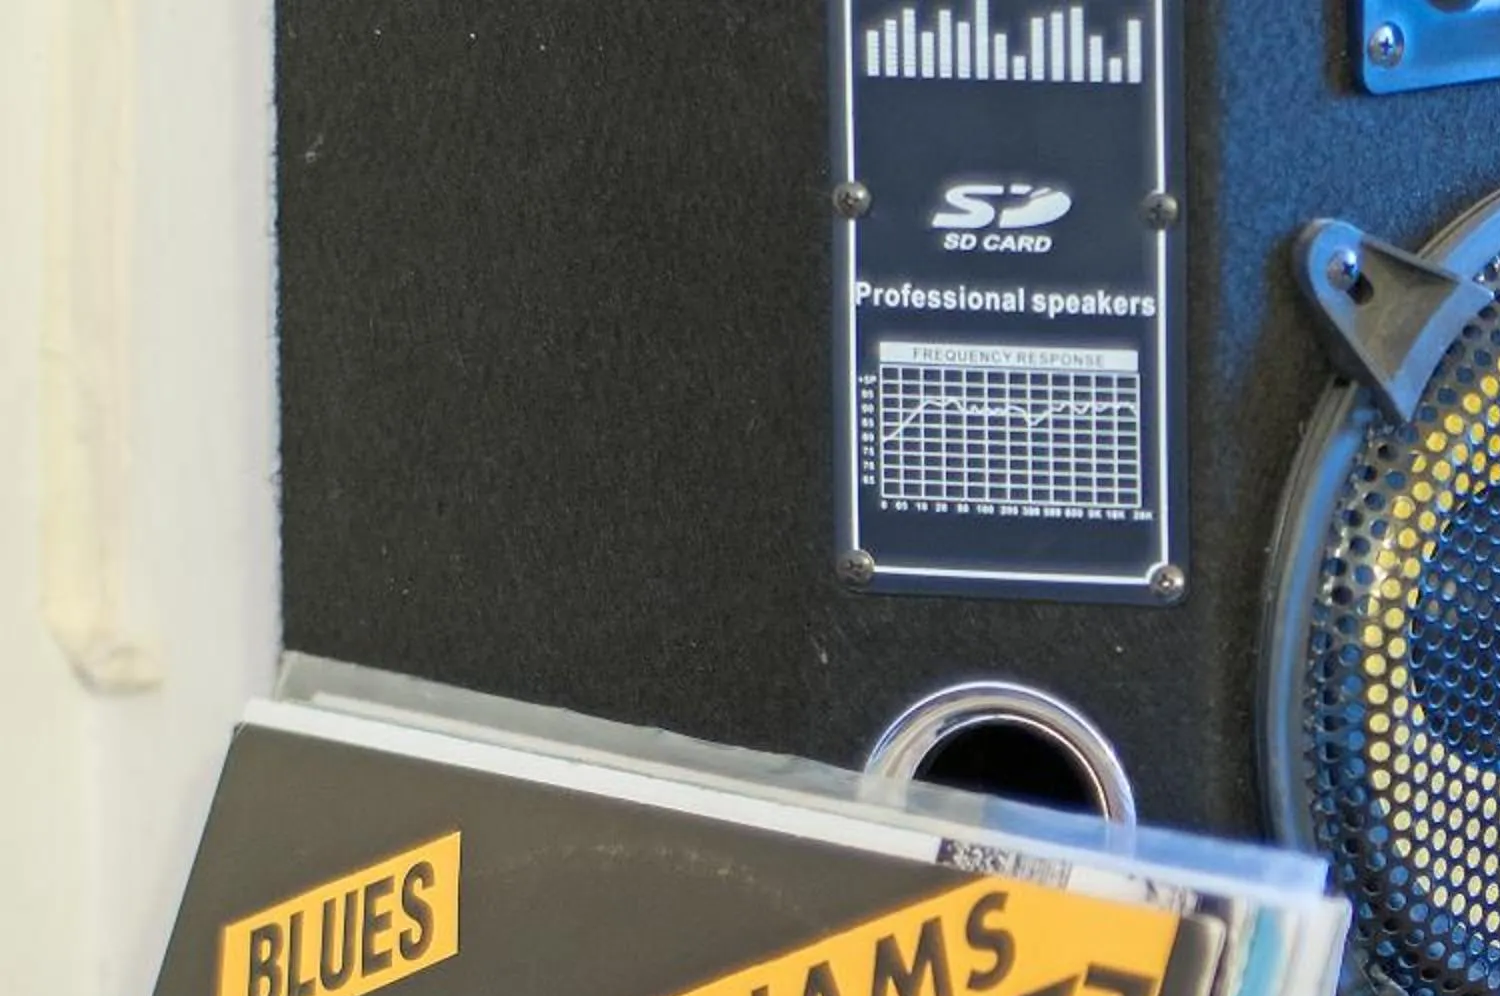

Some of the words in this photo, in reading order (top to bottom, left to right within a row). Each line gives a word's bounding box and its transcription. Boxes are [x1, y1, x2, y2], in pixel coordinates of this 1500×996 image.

[943, 232, 977, 251] SD
[983, 234, 1053, 253] CARD
[855, 281, 1025, 313] Professional
[1031, 290, 1157, 319] speakers
[912, 346, 1012, 364] FREQUENCY
[1016, 351, 1105, 369] RESPONSE
